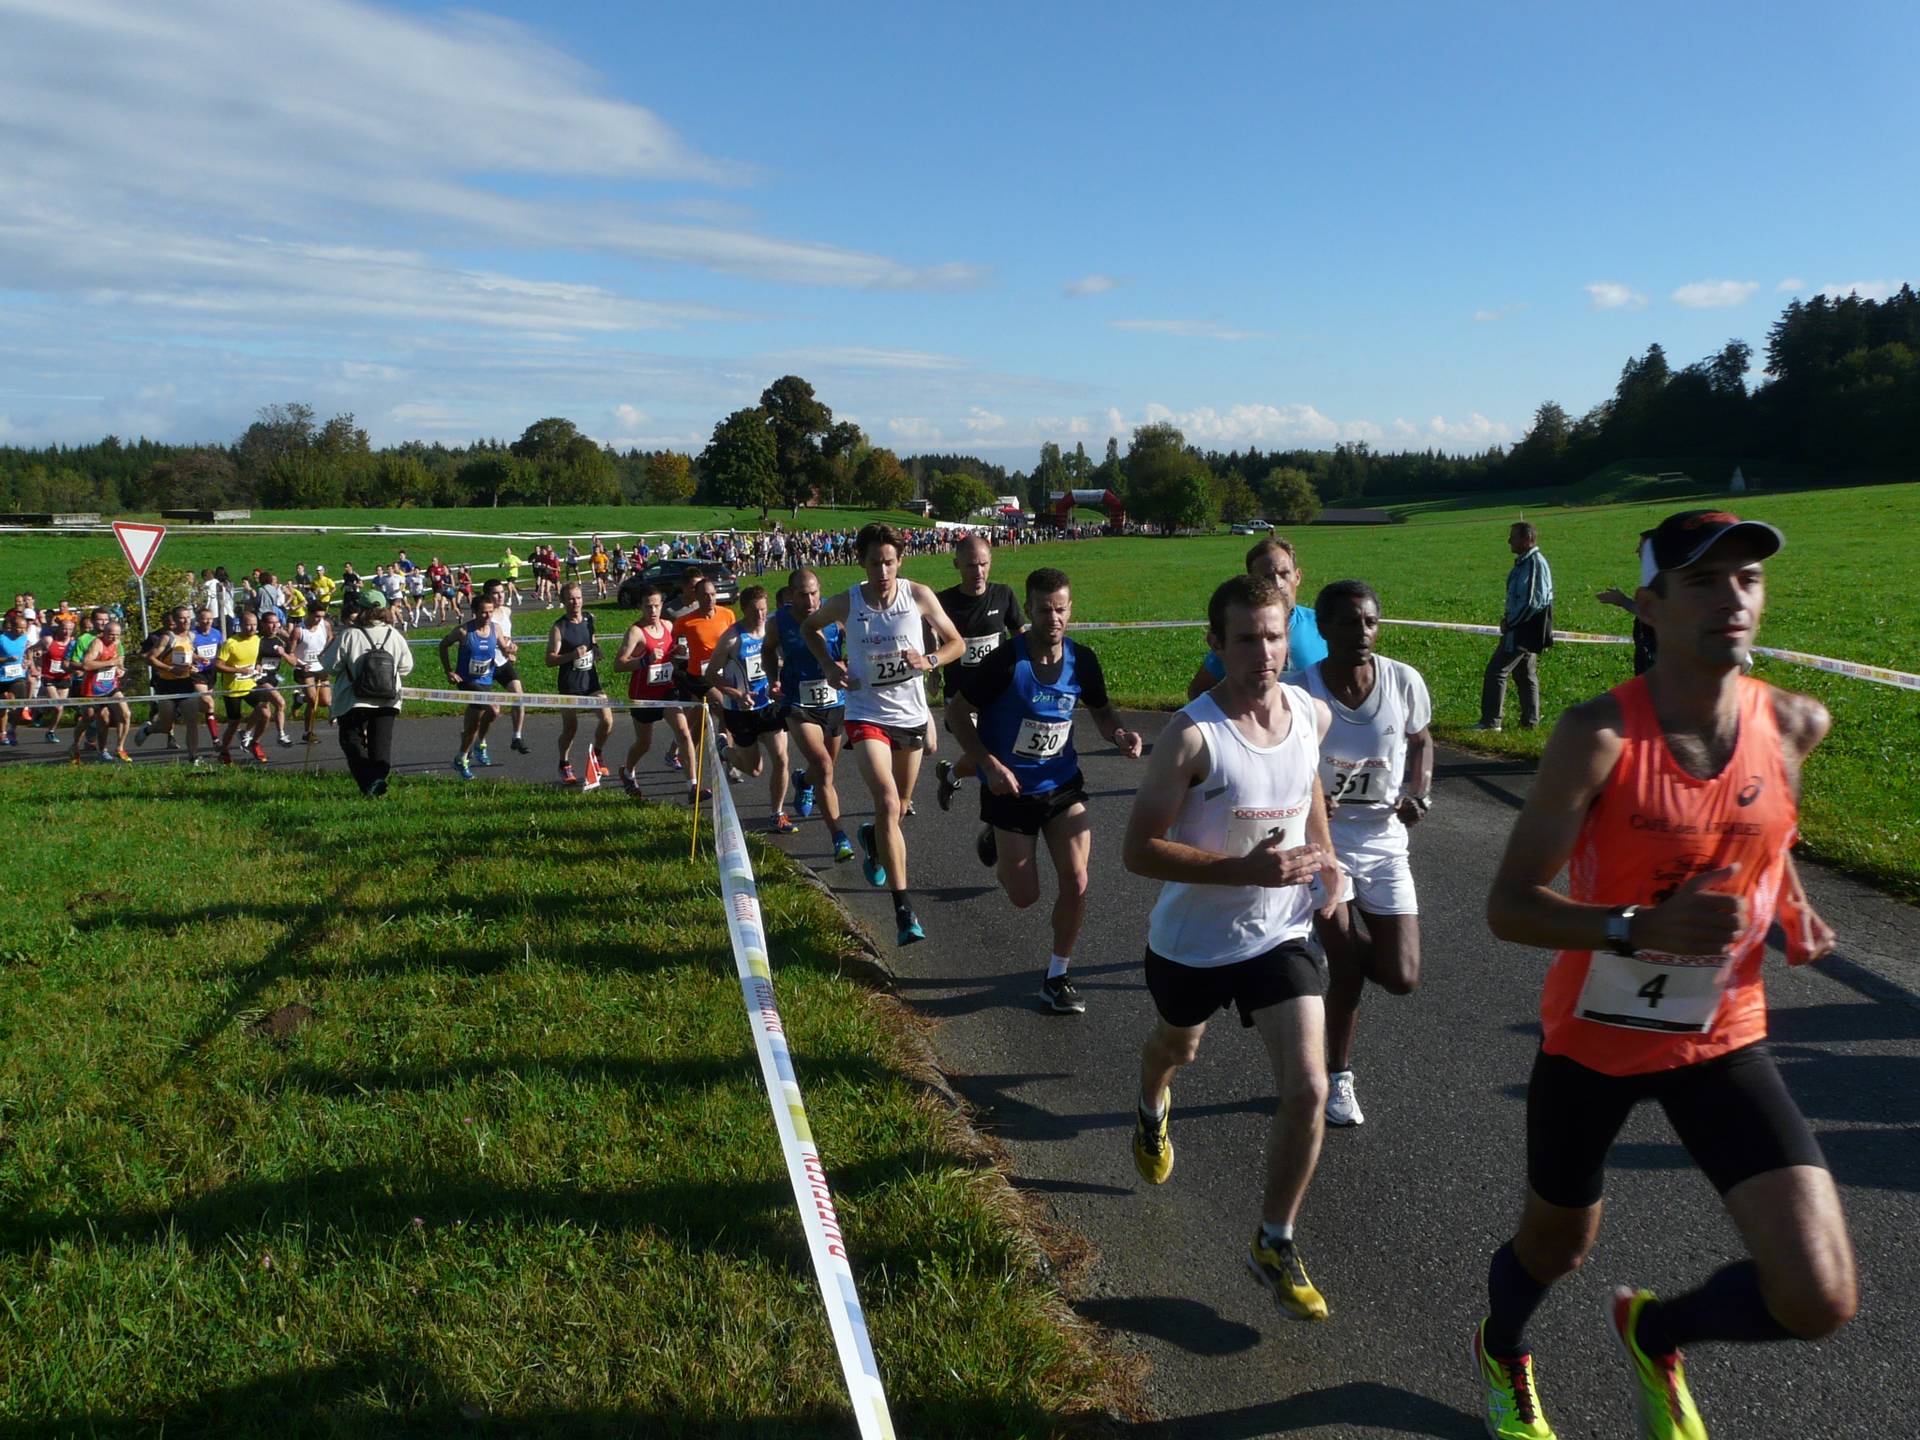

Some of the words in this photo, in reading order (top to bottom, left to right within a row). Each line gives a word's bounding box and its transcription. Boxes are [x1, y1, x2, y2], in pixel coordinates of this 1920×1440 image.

[877, 660, 906, 679] 234
[809, 687, 829, 701] 133
[1027, 733, 1058, 751] 520
[1331, 772, 1371, 796] 351
[1235, 809, 1285, 818] OCHSNER
[1286, 807, 1303, 817] SPO
[1637, 973, 1668, 1008] 4
